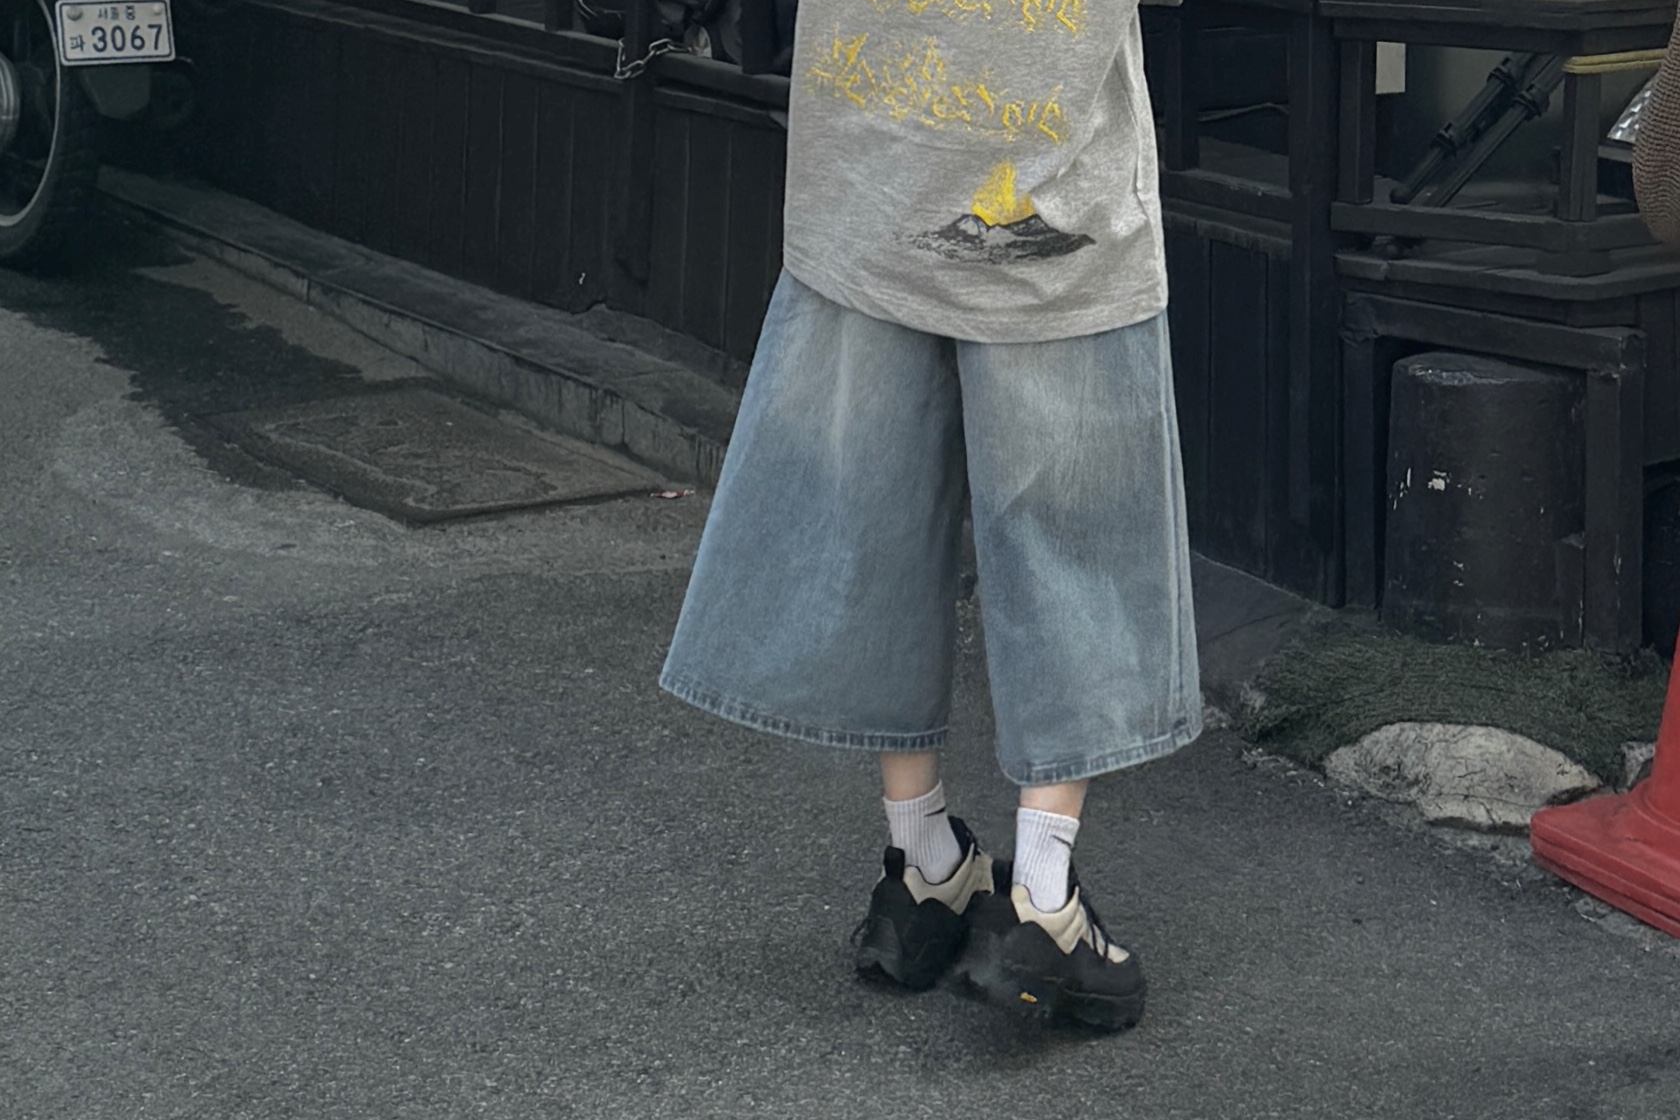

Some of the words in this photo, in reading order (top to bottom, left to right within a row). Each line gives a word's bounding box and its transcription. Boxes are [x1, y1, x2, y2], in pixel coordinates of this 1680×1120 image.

[97, 7, 120, 21] 서울
[69, 34, 86, 52] 파
[91, 24, 163, 53] 3067
